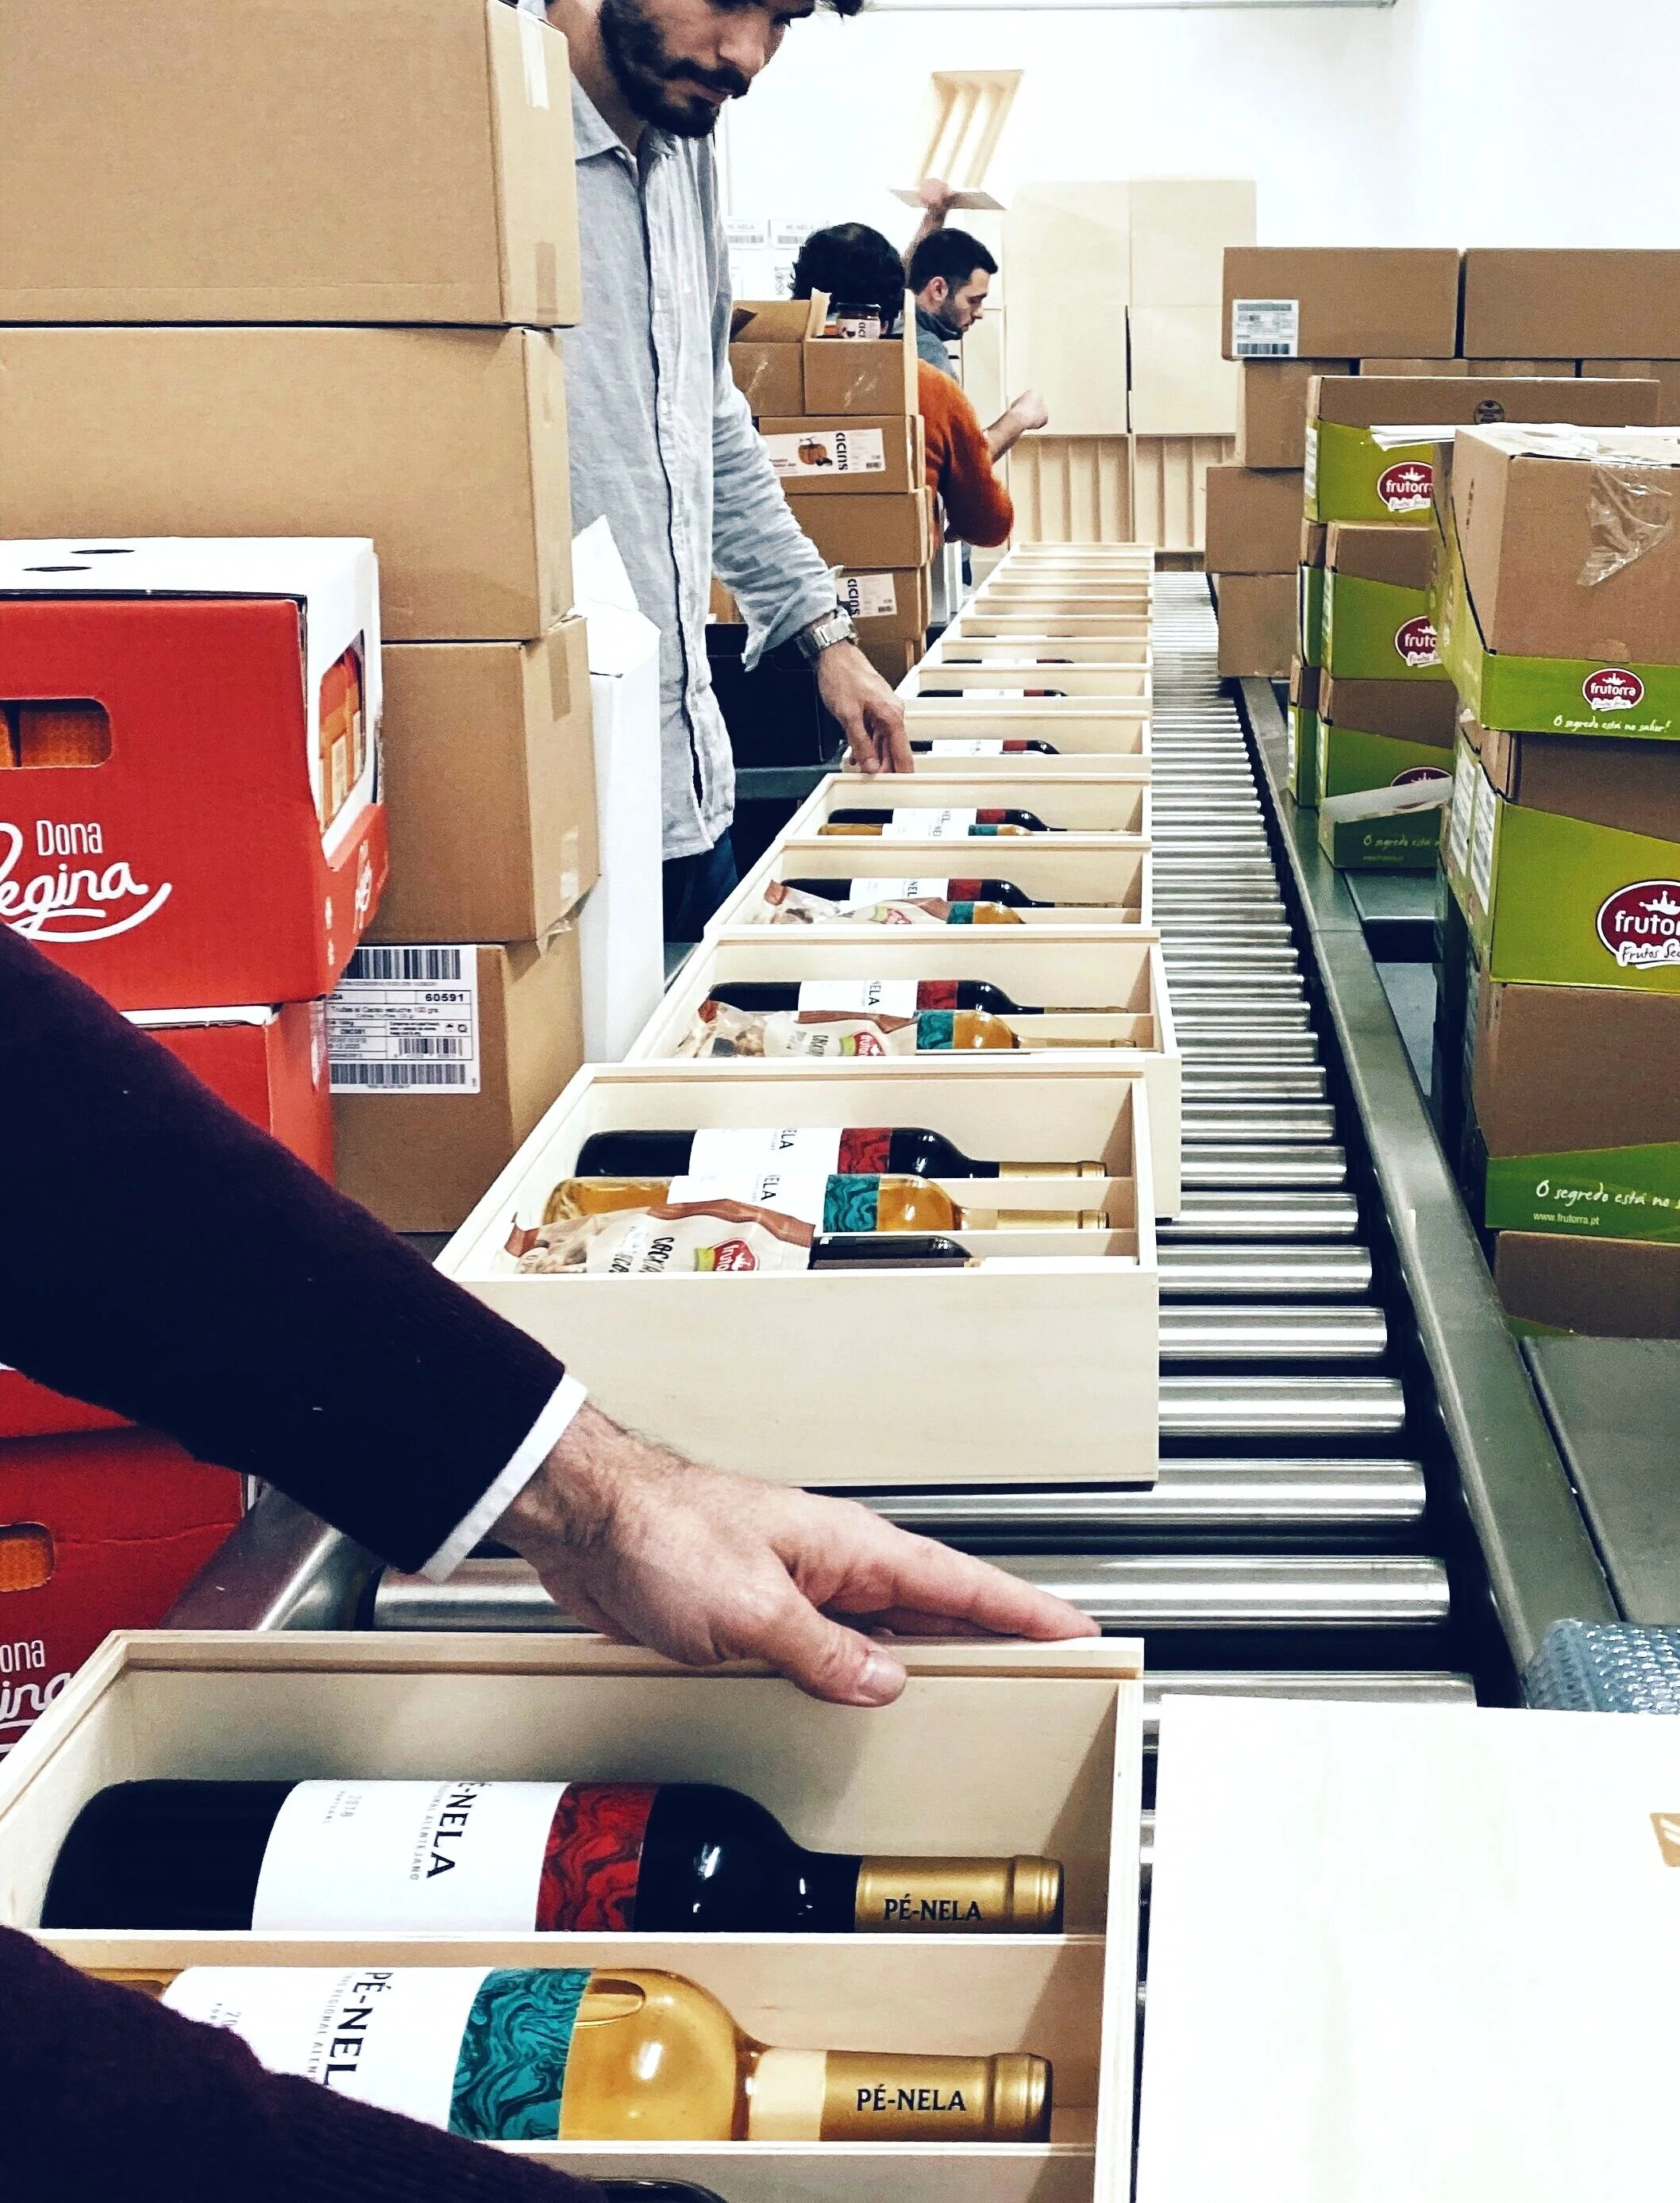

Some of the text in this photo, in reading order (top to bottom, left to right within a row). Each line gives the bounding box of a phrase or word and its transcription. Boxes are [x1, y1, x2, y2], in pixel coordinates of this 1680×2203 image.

[1385, 479, 1433, 495] frutorr
[1404, 633, 1436, 648] fruto
[1589, 682, 1636, 697] frutorra
[1553, 714, 1563, 727] O
[36, 819, 103, 857] Dona
[1615, 910, 1680, 937] fruto
[1622, 945, 1659, 962] Frutos
[425, 992, 464, 1003] 60591
[1536, 1179, 1550, 1198] O
[1553, 1181, 1609, 1207] segredo
[1651, 1196, 1670, 1207] no
[0, 1639, 46, 1673] ona
[883, 1893, 983, 1922] PÉ-NELA
[221, 2011, 242, 2028] 20
[323, 1972, 394, 2087] PÉ-NEL
[306, 2042, 325, 2075] ALEN
[855, 2083, 967, 2112] PÉ-NELA
